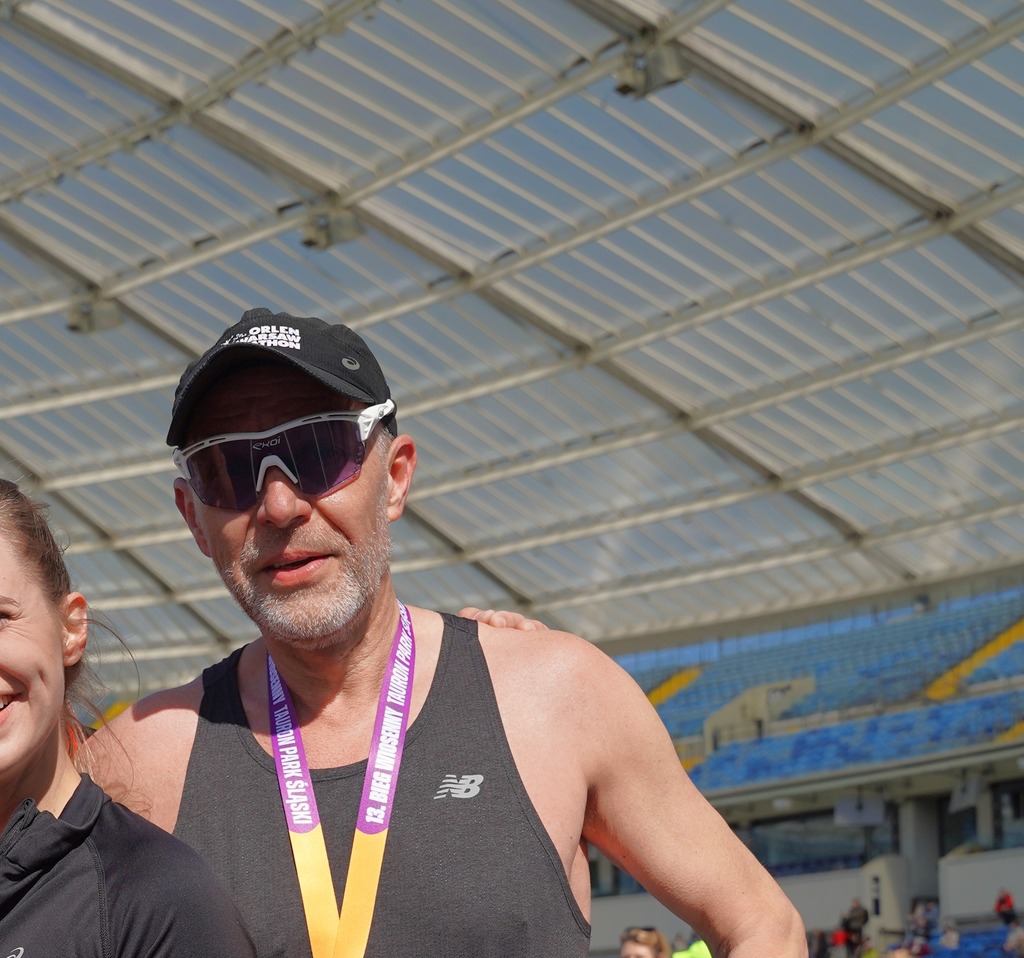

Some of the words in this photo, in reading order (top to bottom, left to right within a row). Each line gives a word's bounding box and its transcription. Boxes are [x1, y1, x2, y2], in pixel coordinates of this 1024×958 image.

[249, 325, 300, 336] ORLEN
[396, 627, 413, 666] PARK
[386, 659, 410, 707] TAURON
[274, 704, 296, 746] TAURON
[375, 706, 404, 774] WIOSENNY
[278, 746, 303, 783] PARK
[286, 780, 313, 825] ŚLĄSKI
[369, 771, 392, 803] BIEG
[365, 804, 386, 825] 13.
